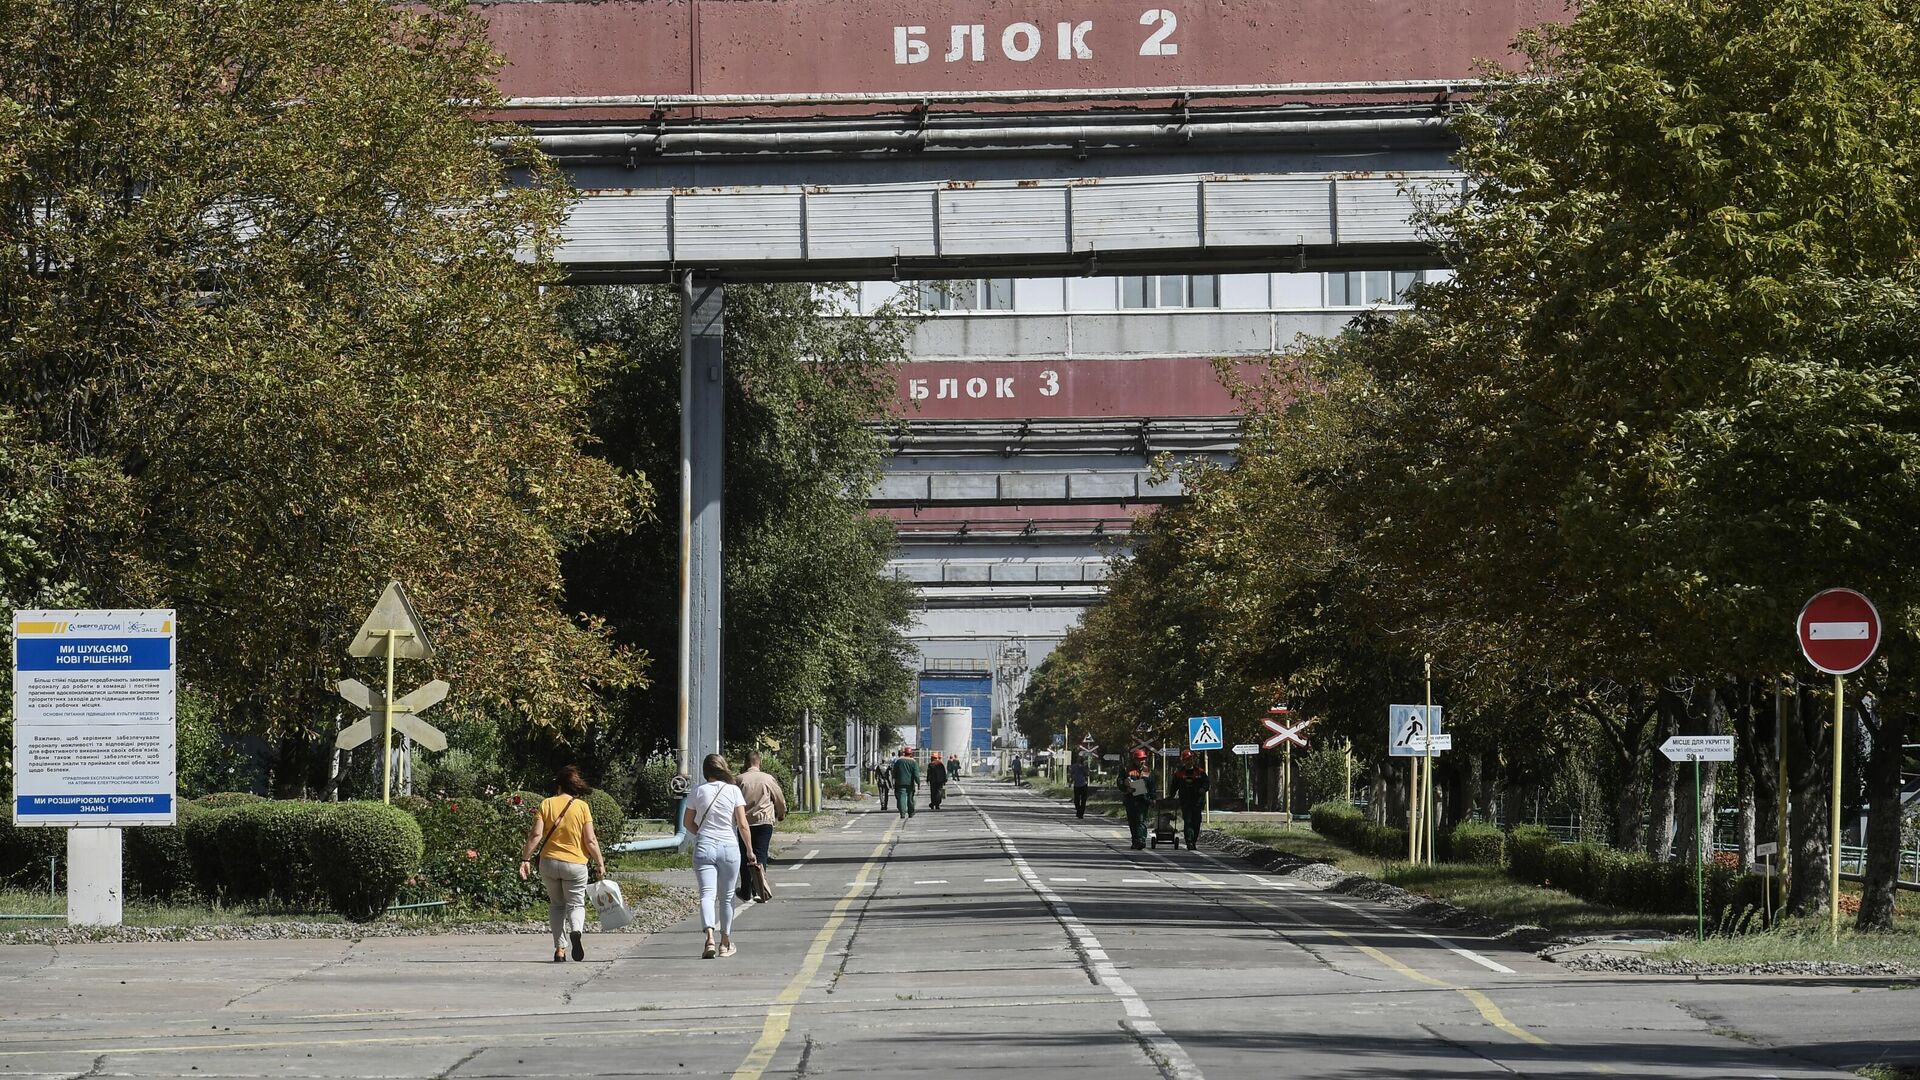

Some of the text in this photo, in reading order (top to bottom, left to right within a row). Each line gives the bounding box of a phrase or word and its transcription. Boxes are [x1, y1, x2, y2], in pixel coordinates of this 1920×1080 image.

[894, 9, 1180, 64] БЛОК 2
[910, 371, 1059, 399] БЛОК 3
[78, 645, 128, 653] ШУКАЄМО
